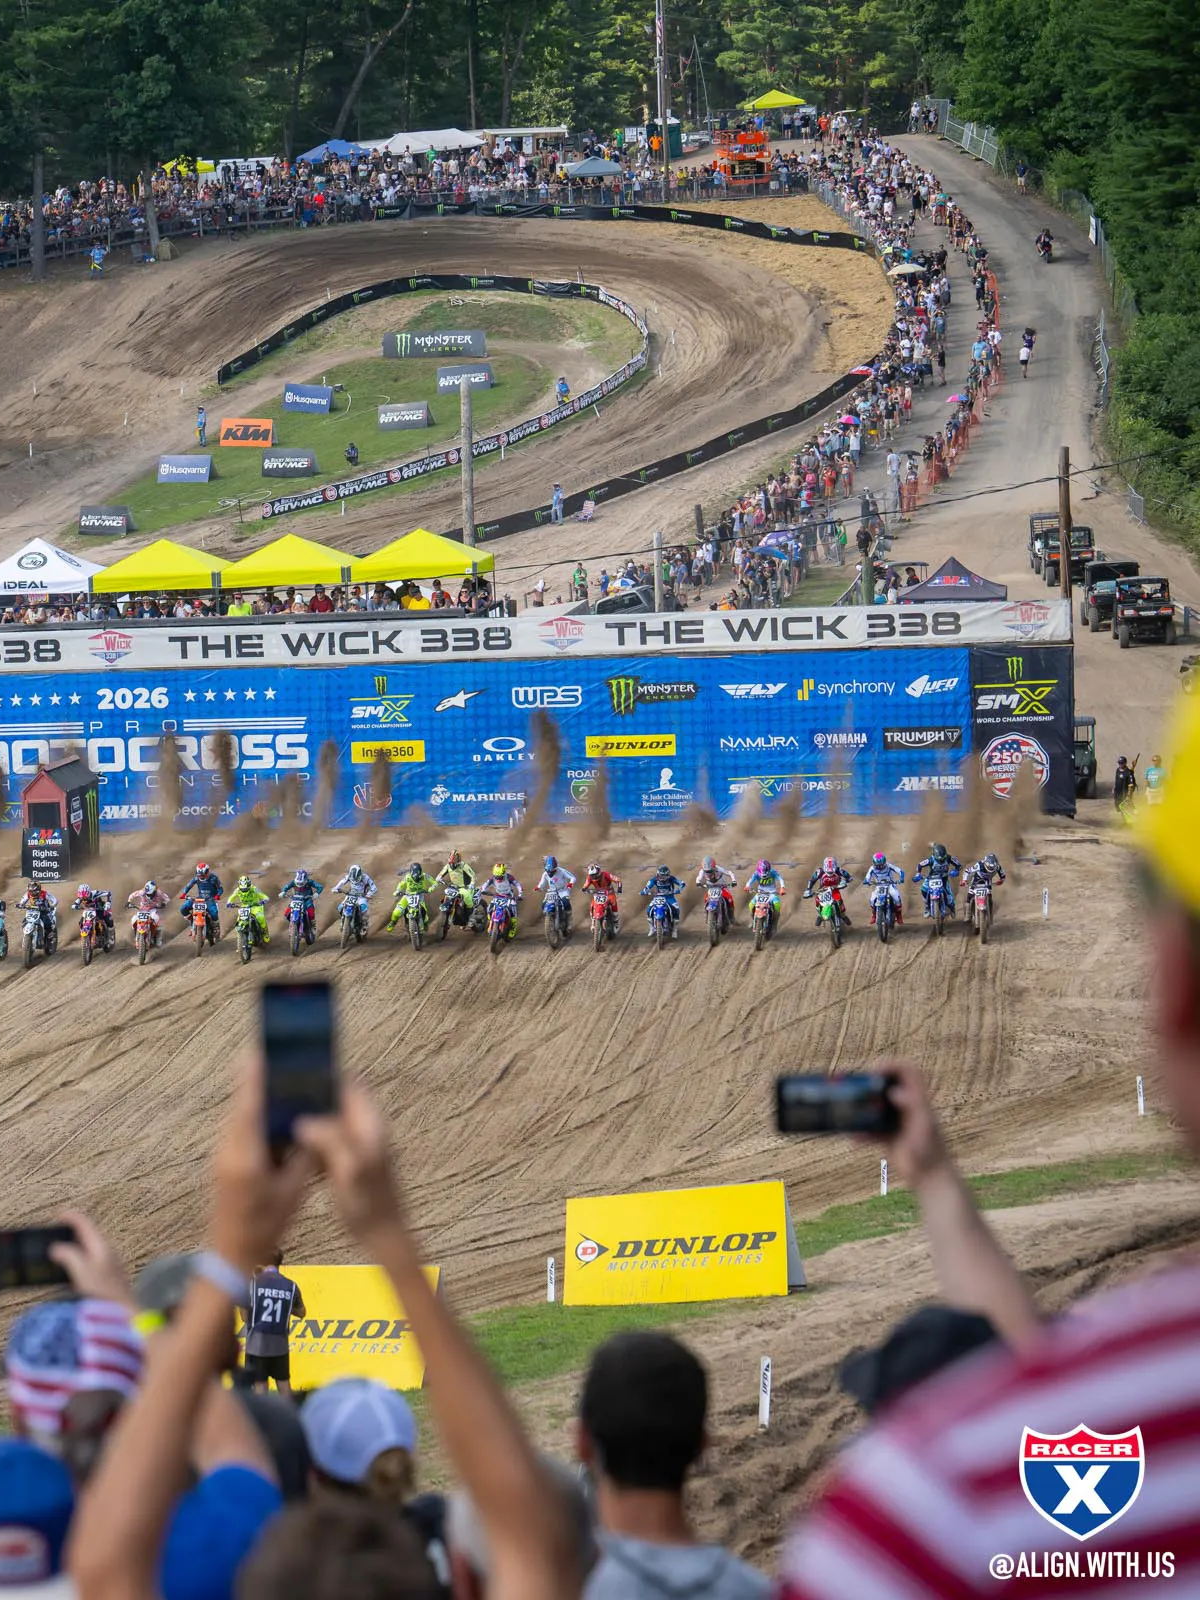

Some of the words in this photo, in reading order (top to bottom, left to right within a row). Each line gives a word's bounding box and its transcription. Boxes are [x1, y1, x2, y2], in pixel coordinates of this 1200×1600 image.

[415, 335, 472, 346] MONSTER
[293, 395, 328, 405] Husqvarna
[222, 424, 271, 441] KTM
[170, 466, 208, 474] Husqvarna
[3, 581, 48, 590] IDEAL
[605, 620, 704, 646] THE
[722, 615, 848, 642] WICK
[866, 611, 962, 638] 338
[167, 634, 265, 659] THE
[281, 630, 404, 657] WICK
[420, 627, 512, 653] 338
[637, 684, 696, 695] MONSTER
[719, 682, 788, 695] FLY
[818, 679, 895, 697] synchrony
[96, 686, 169, 710] 2026
[512, 686, 582, 709] WPS
[975, 687, 1053, 715] SMX
[351, 700, 411, 723] SMX
[90, 719, 177, 733] PRO
[720, 735, 799, 748] NAMURA
[826, 733, 867, 745] YAMAHA
[884, 731, 945, 744] TRIUMPH
[603, 741, 672, 750] DUNLOP
[473, 752, 536, 762] OAKLEY
[991, 752, 1022, 764] 250
[567, 770, 600, 778] ROAD
[940, 776, 964, 785] PRO
[452, 792, 527, 802] MARINES
[578, 786, 589, 799] 2
[32, 849, 59, 859] Rights.
[32, 860, 60, 868] Riding.
[32, 870, 61, 879] Racing.
[612, 1231, 777, 1258] DUNLOP
[606, 1257, 709, 1271] MOTORCYCLE
[719, 1253, 763, 1266] TIRES
[258, 1287, 291, 1300] PRESS
[261, 1299, 282, 1323] 21
[351, 1342, 402, 1354] TIRES
